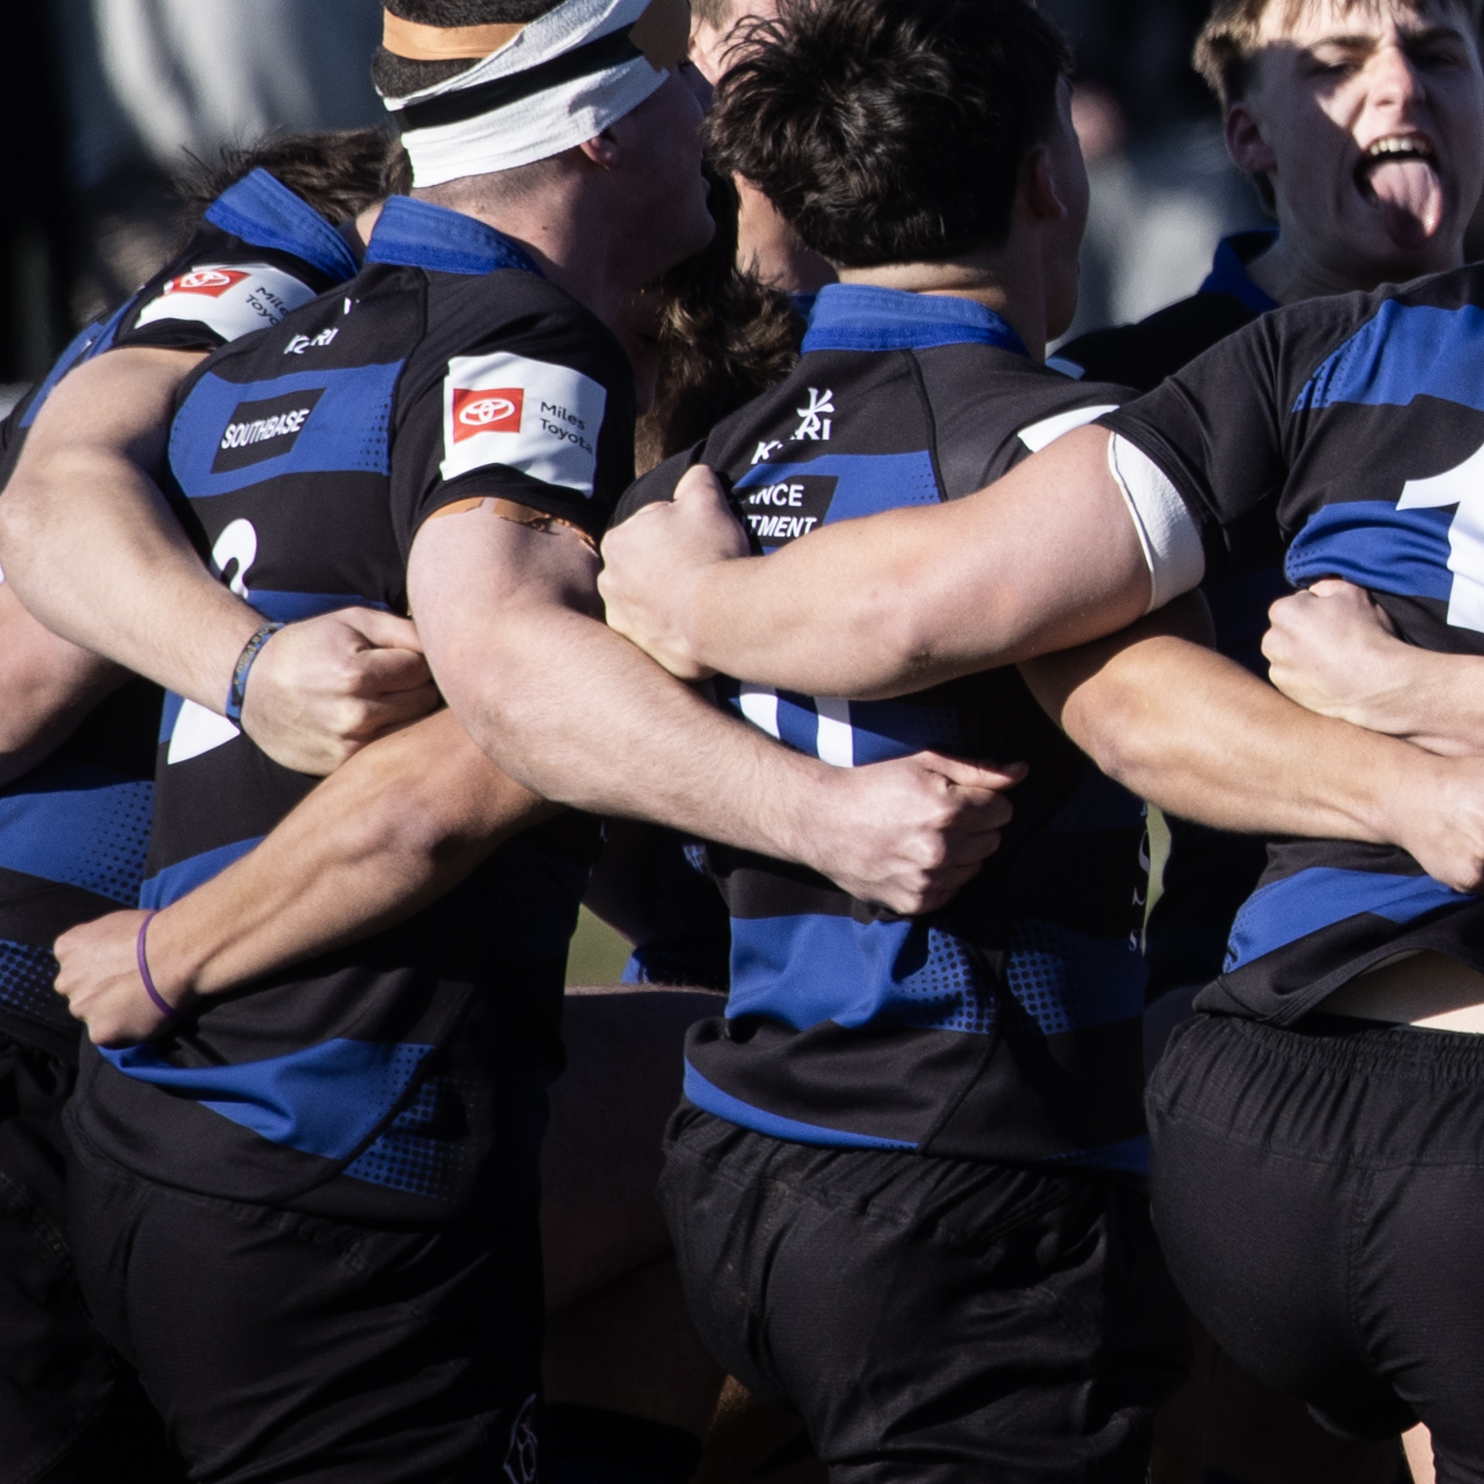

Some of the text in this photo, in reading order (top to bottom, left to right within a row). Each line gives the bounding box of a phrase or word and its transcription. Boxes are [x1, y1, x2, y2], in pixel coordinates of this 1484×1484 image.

[245, 293, 281, 328] Toyo
[221, 408, 310, 449] SOUTHBASE
[540, 400, 587, 431] Miles
[539, 417, 595, 456] Toyota
